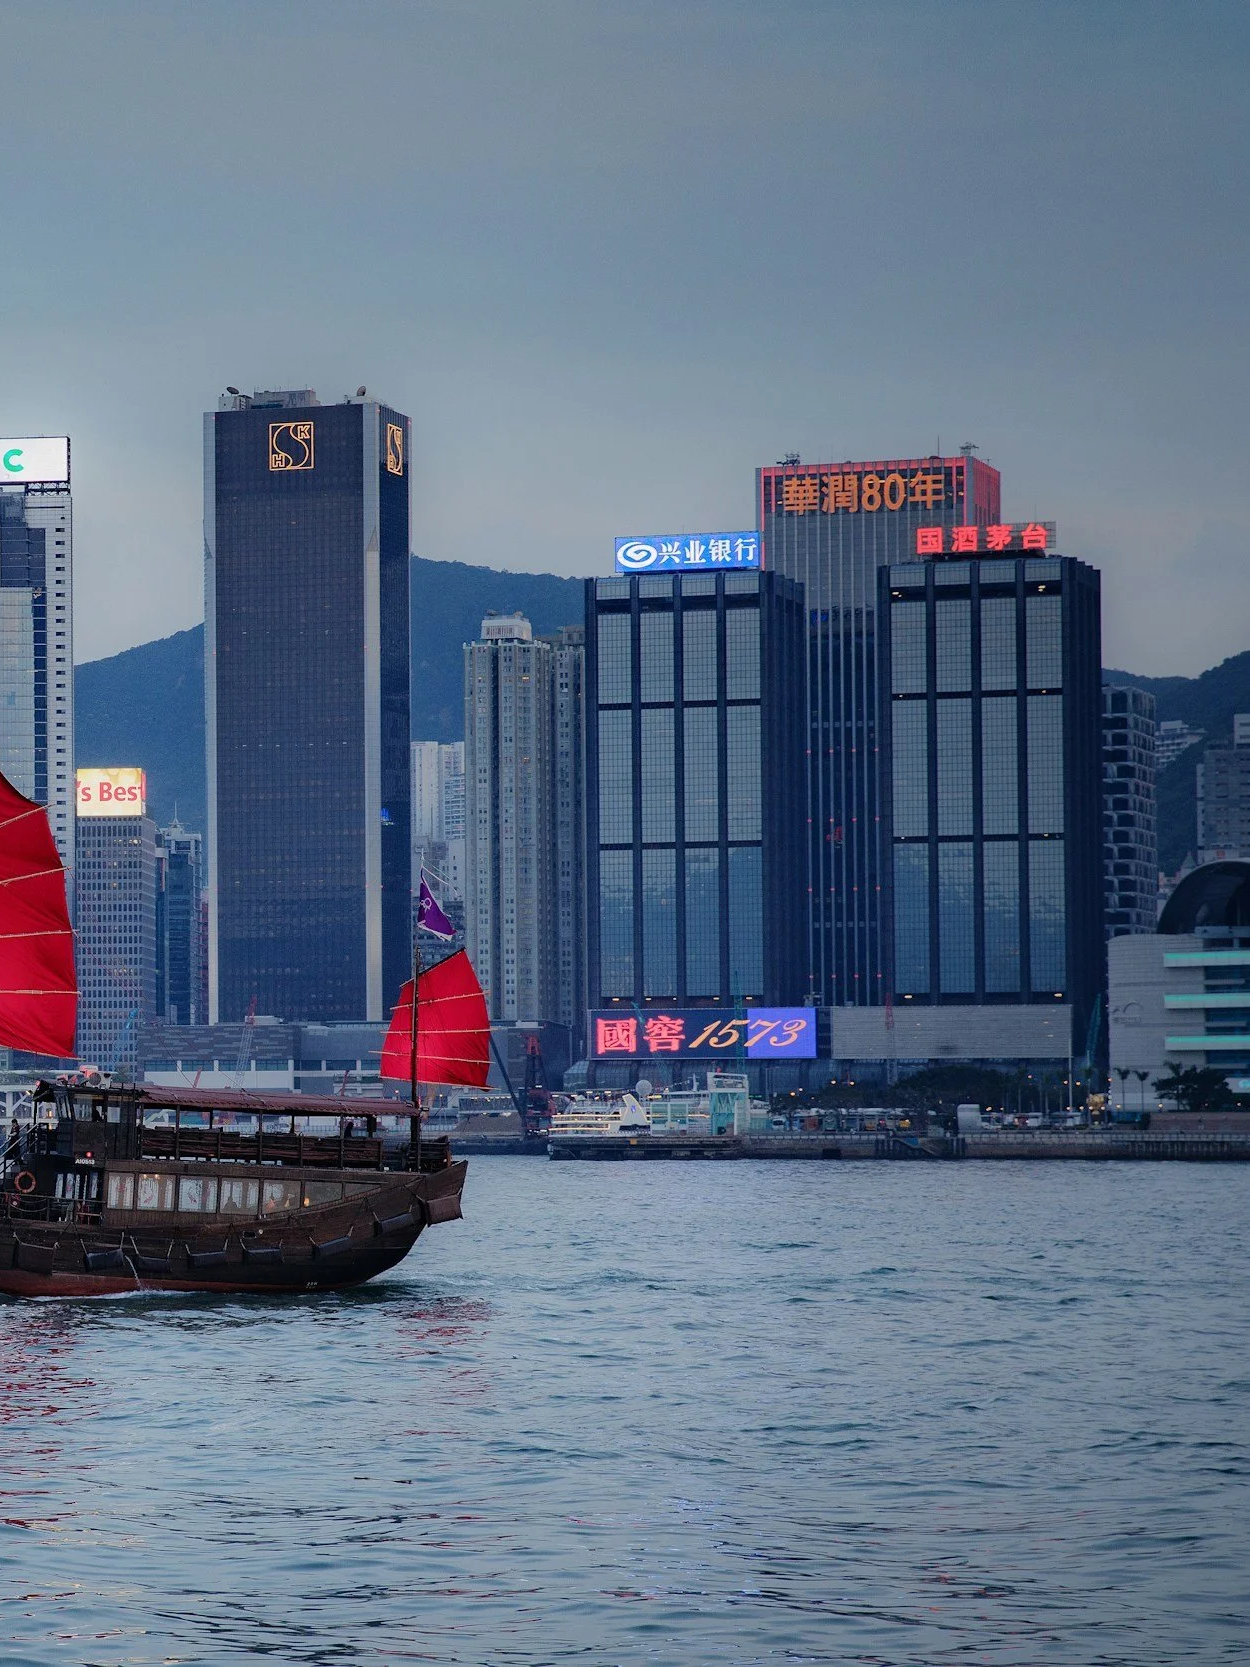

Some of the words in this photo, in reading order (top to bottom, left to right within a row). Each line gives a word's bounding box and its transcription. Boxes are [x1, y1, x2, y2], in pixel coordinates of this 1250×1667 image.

[3, 449, 24, 472] C
[782, 472, 945, 515] 華潤80年
[658, 537, 758, 565] 兴业银行
[916, 522, 1049, 555] 国酒茅台
[688, 1018, 808, 1049] 1573
